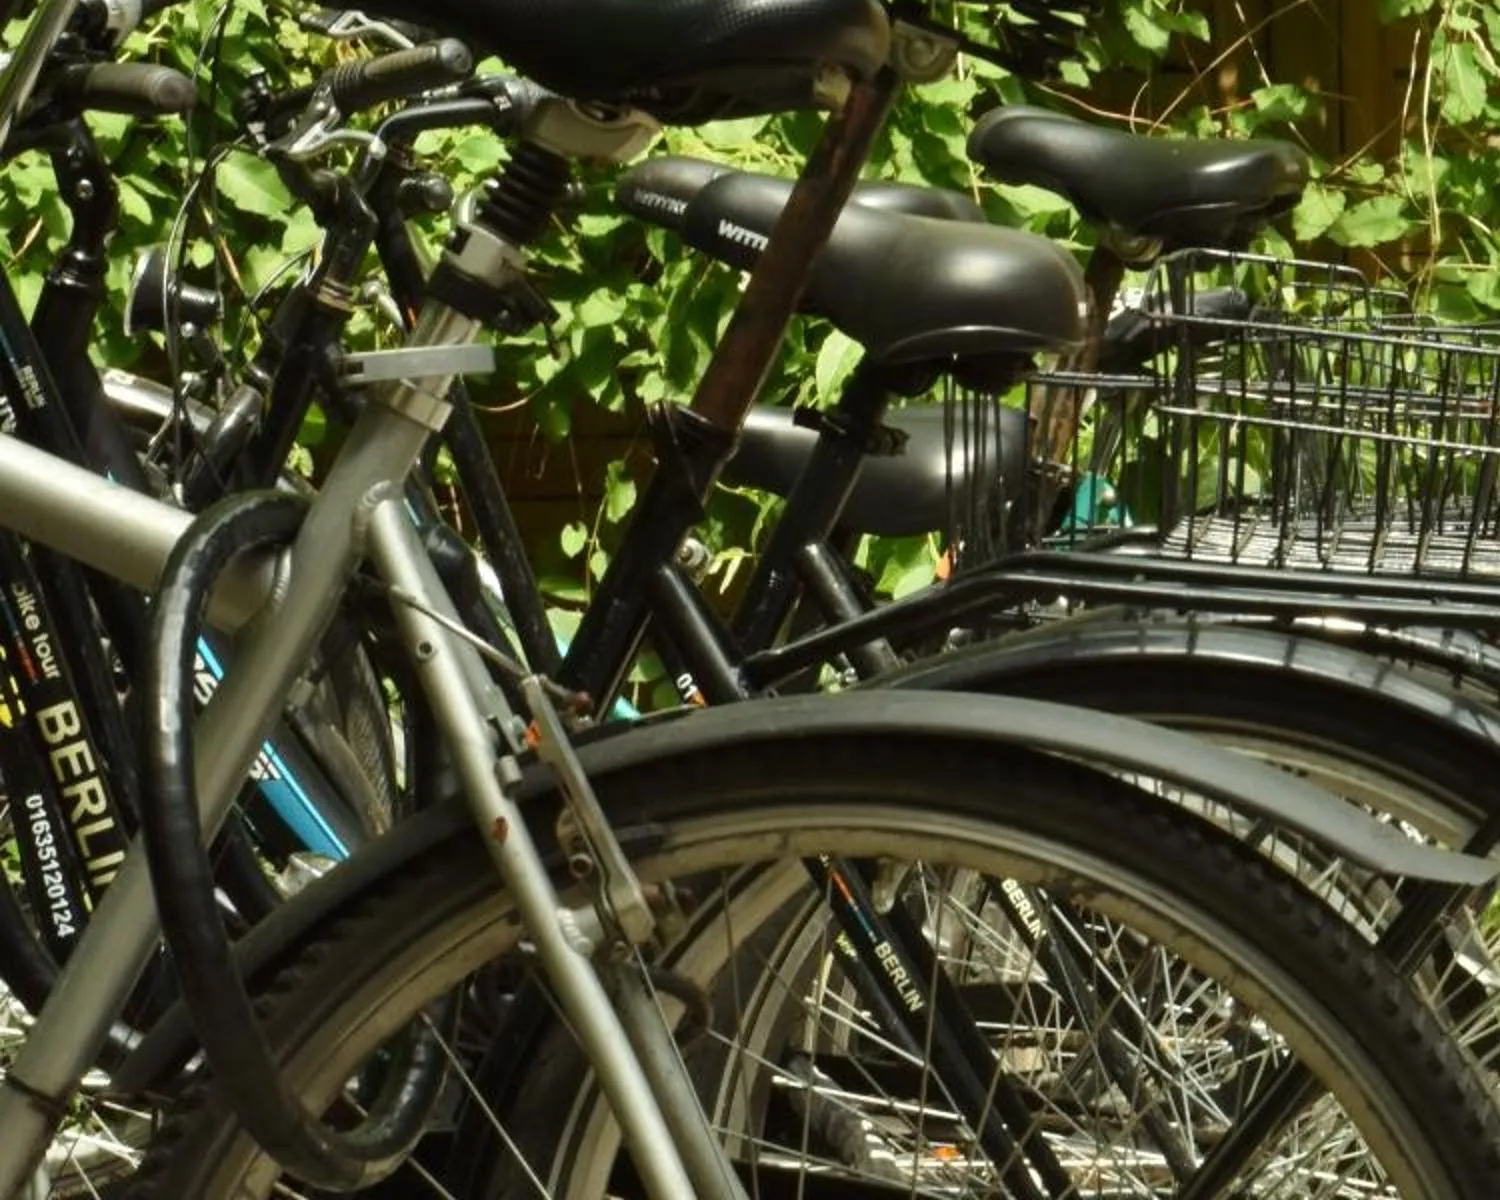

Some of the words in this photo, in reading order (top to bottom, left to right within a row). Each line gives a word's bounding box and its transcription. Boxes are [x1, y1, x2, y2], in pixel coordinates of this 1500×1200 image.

[32, 632, 61, 680] tour
[25, 793, 76, 938] 01635120124
[1001, 878, 1047, 940] BERLIN
[874, 940, 925, 1013] BERLIN
